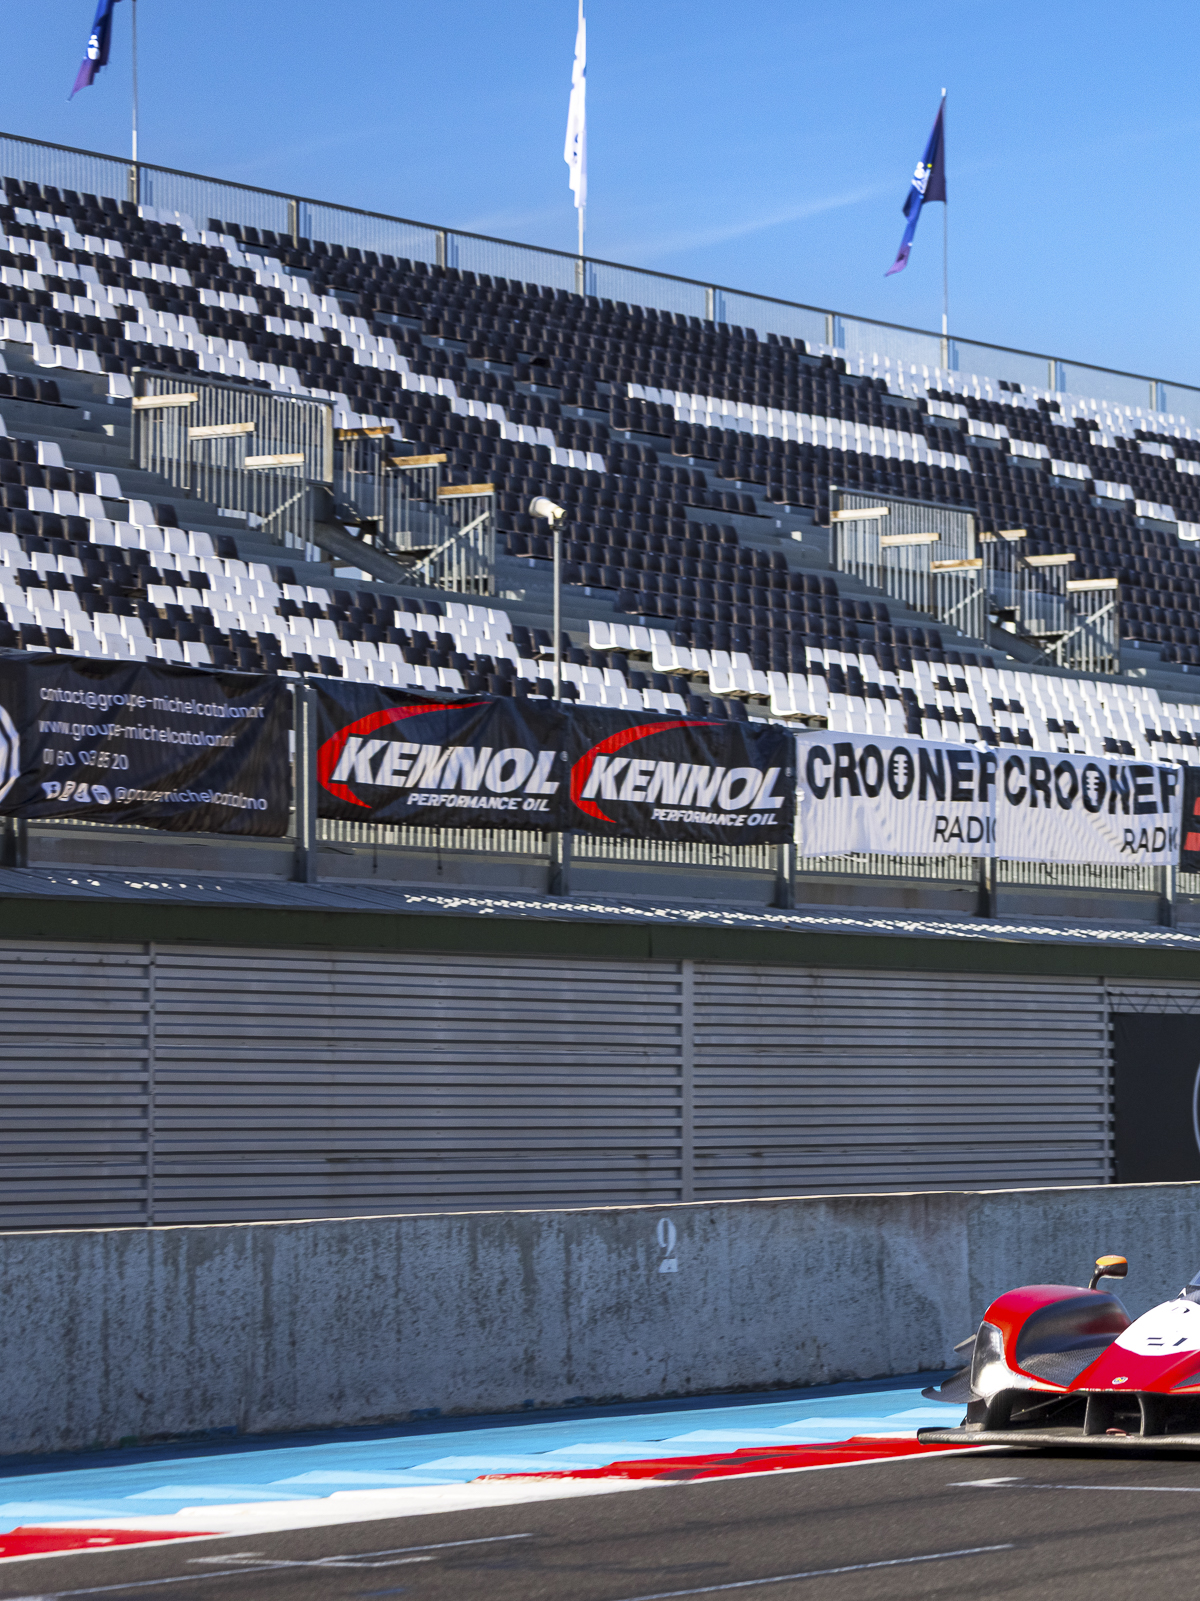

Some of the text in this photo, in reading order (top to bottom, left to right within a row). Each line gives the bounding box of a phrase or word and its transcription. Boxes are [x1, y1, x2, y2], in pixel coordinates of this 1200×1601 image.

[56, 750, 76, 766] 60
[111, 753, 129, 770] 20
[331, 737, 560, 794] KENNOL
[580, 755, 785, 810] KENNOL
[407, 793, 550, 811] PERFORMANCE OIL
[651, 808, 778, 826] PERFORMANCE OIL
[656, 1217, 679, 1273] 2
